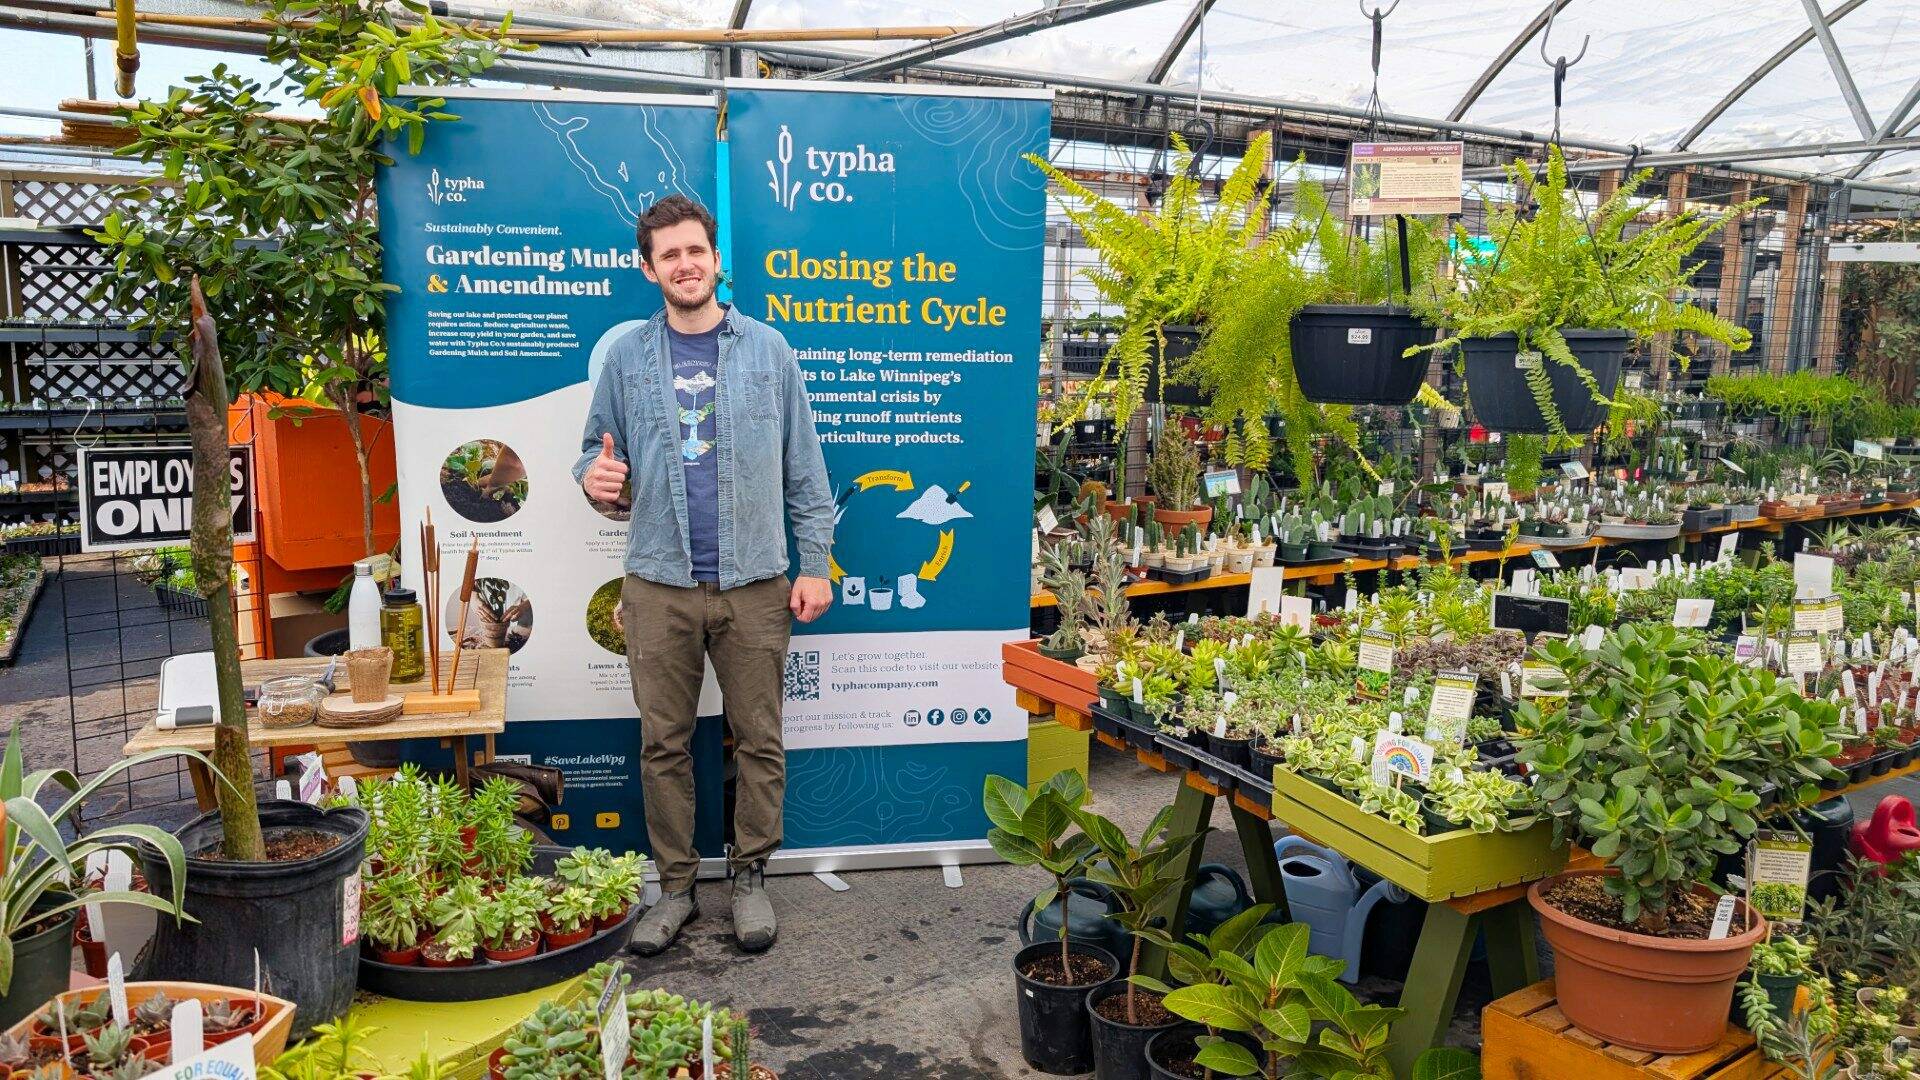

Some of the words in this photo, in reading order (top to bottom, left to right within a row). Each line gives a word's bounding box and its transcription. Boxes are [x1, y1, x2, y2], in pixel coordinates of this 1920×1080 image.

[806, 144, 896, 178] typha
[445, 177, 485, 190] typha
[447, 192, 466, 202] co.
[809, 181, 853, 202] co.
[425, 223, 493, 236] Sustainably
[497, 224, 562, 236] Convenient.
[426, 244, 566, 272] Gardening
[571, 248, 644, 269] Mulch
[765, 249, 894, 288] Closing
[902, 252, 956, 283] the
[427, 274, 449, 294] &
[455, 274, 612, 296] Amendment
[765, 294, 911, 325] Nutrient
[921, 297, 1007, 332] Cycle
[467, 340, 489, 348] Typha
[429, 349, 466, 357] Gardening
[794, 348, 846, 364] taining
[849, 348, 922, 365] long-term
[925, 350, 1013, 363] remediation
[821, 370, 835, 381] to
[839, 369, 875, 382] Lake
[879, 370, 961, 385] Winnipeg's
[807, 390, 876, 403] onmental
[880, 391, 919, 403] crisis
[923, 391, 942, 405] by
[844, 411, 892, 424] runoff
[895, 411, 962, 424] nutrients
[895, 431, 964, 446] products.
[93, 458, 244, 496] EMPLOYS
[867, 473, 903, 483] Transform
[469, 530, 523, 538] Amendment
[831, 652, 854, 661] Let's
[857, 653, 881, 662] grow
[831, 664, 856, 674] Scan
[859, 664, 878, 673] this
[880, 663, 905, 673] code
[907, 664, 916, 672] to
[919, 662, 939, 671] visit
[831, 679, 939, 692] typhacompany.com
[784, 713, 803, 724] port
[805, 714, 821, 722] our
[823, 711, 857, 720] mission
[859, 711, 866, 719] &
[869, 710, 891, 718] track
[784, 724, 822, 734] progress
[825, 723, 835, 732] by
[839, 722, 880, 730] following
[1376, 740, 1396, 755] OOTING
[545, 755, 625, 765] #SaveLakeWpg
[175, 1062, 202, 1080] FOR
[207, 1060, 249, 1080] EQUAL
